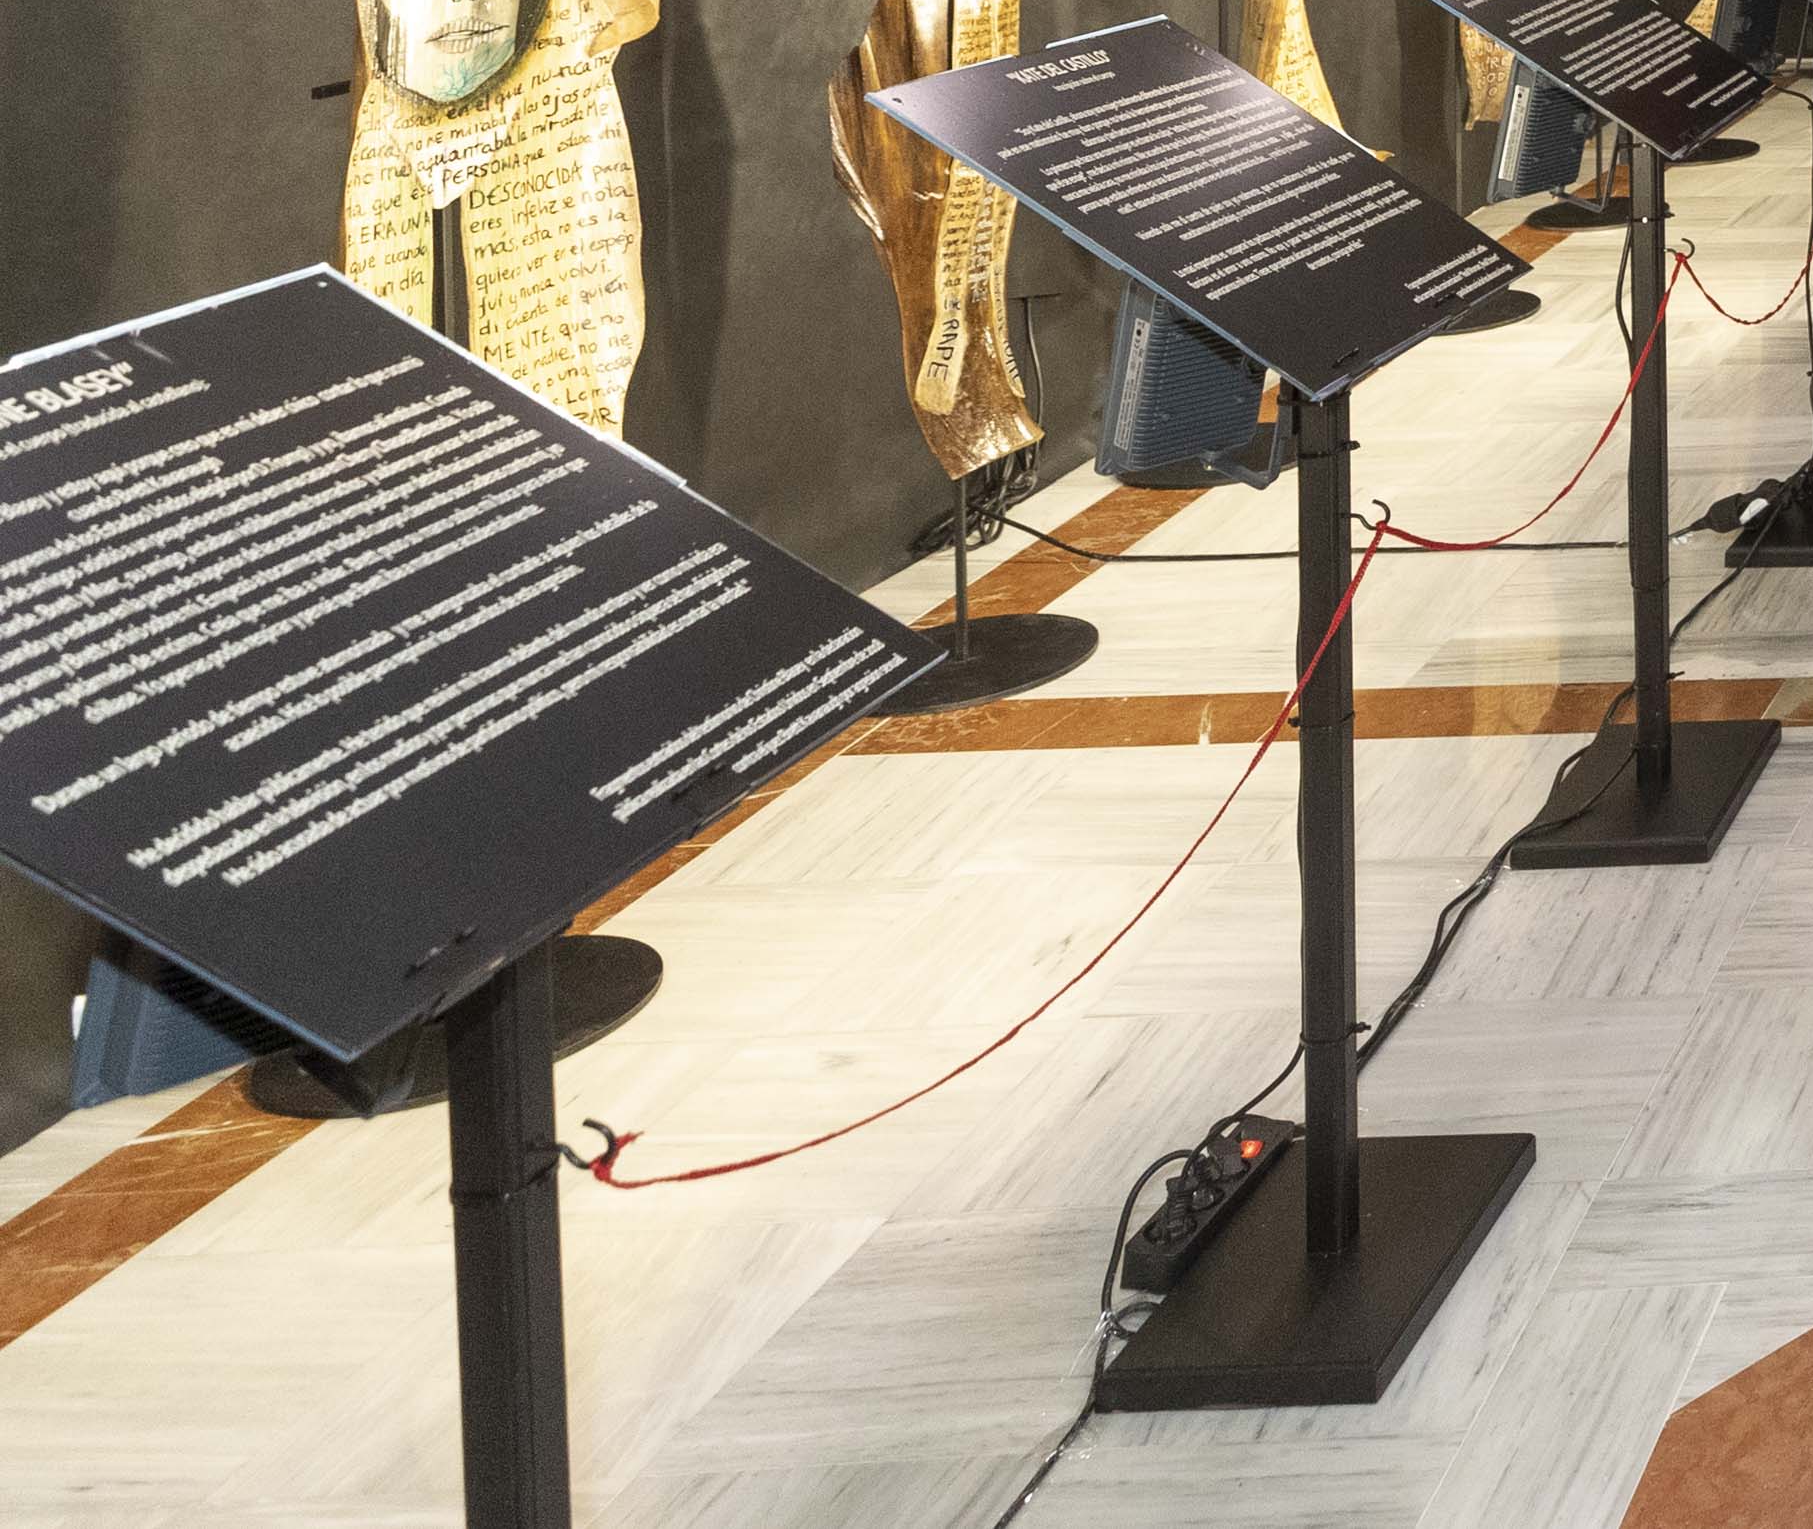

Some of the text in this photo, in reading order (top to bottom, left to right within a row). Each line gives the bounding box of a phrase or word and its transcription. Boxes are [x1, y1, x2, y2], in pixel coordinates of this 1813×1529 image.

[531, 60, 592, 89] nunca
[542, 87, 579, 117] ojos
[442, 154, 520, 190] PERSONA
[361, 220, 397, 244] ERA
[400, 211, 431, 235] UNA
[469, 163, 583, 210] DESCONOCIDA
[470, 218, 503, 234] eres
[522, 222, 553, 247] esta
[559, 318, 597, 342] que
[928, 319, 960, 381] RAPE
